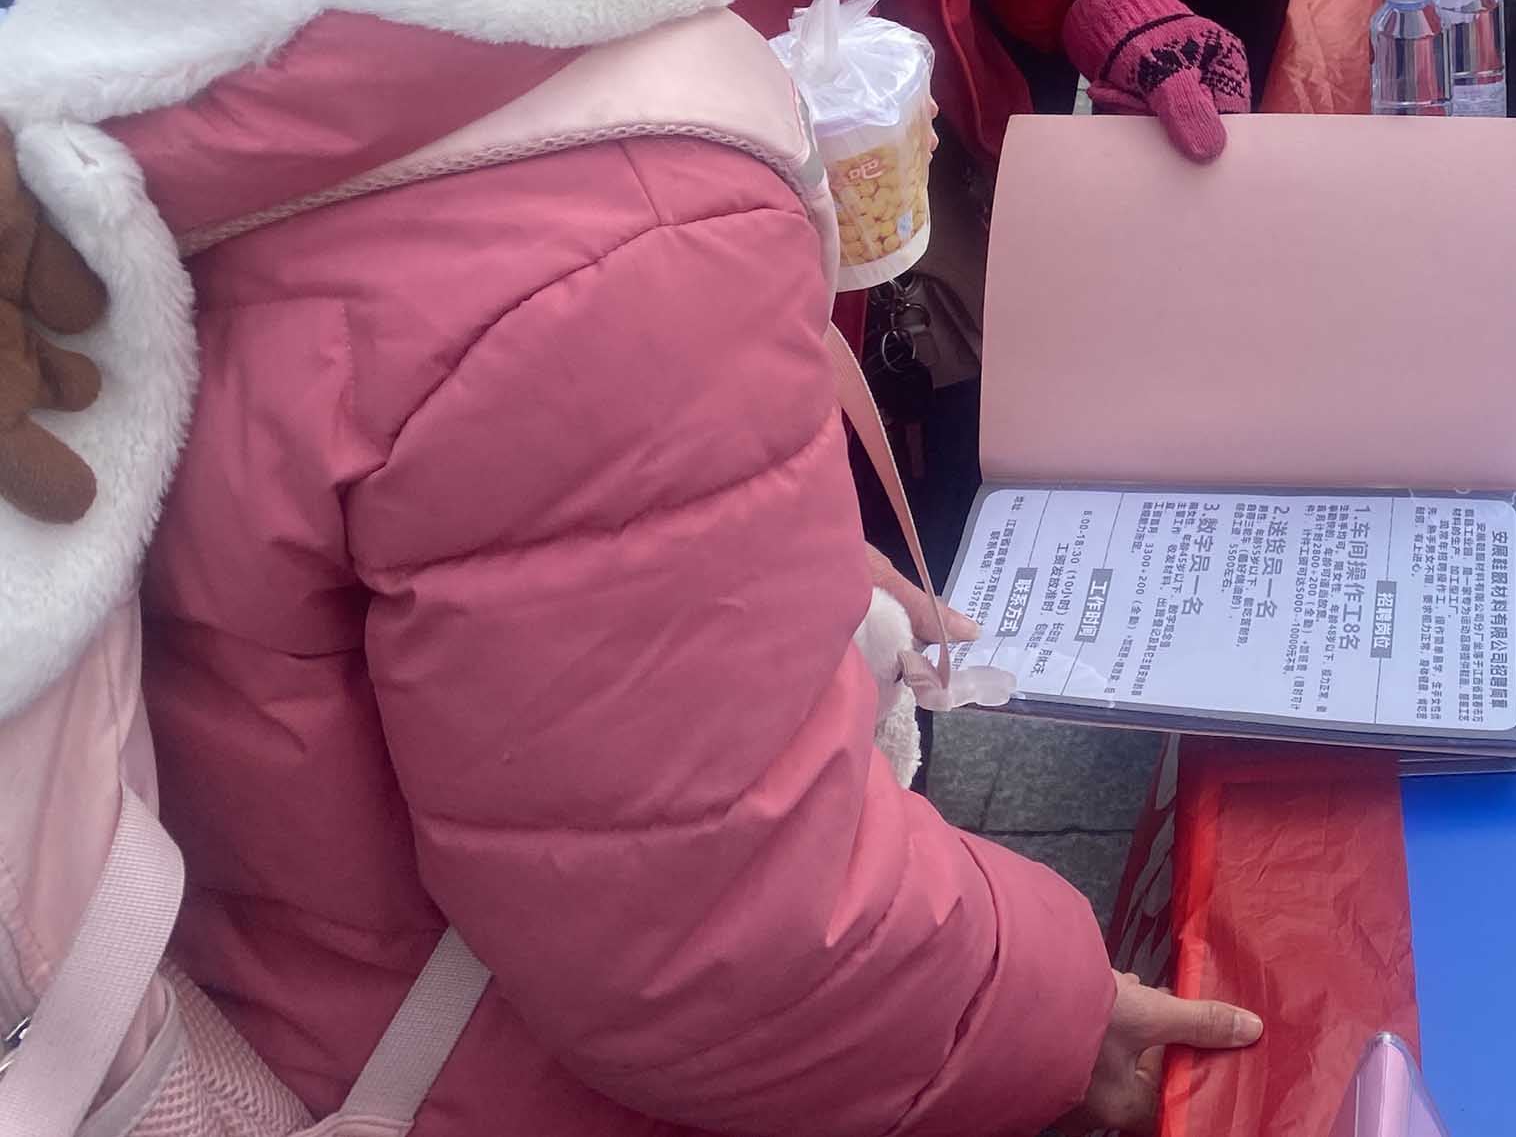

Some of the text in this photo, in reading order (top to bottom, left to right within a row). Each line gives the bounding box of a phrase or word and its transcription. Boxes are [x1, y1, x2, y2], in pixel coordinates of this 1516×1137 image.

[1181, 503, 1220, 616] 3.数字员一名
[1255, 506, 1289, 619] 2.送货员一名
[1000, 579, 1033, 632] 联系方式
[1079, 580, 1108, 638] 工作时间
[1373, 592, 1393, 649] 招聘岗位
